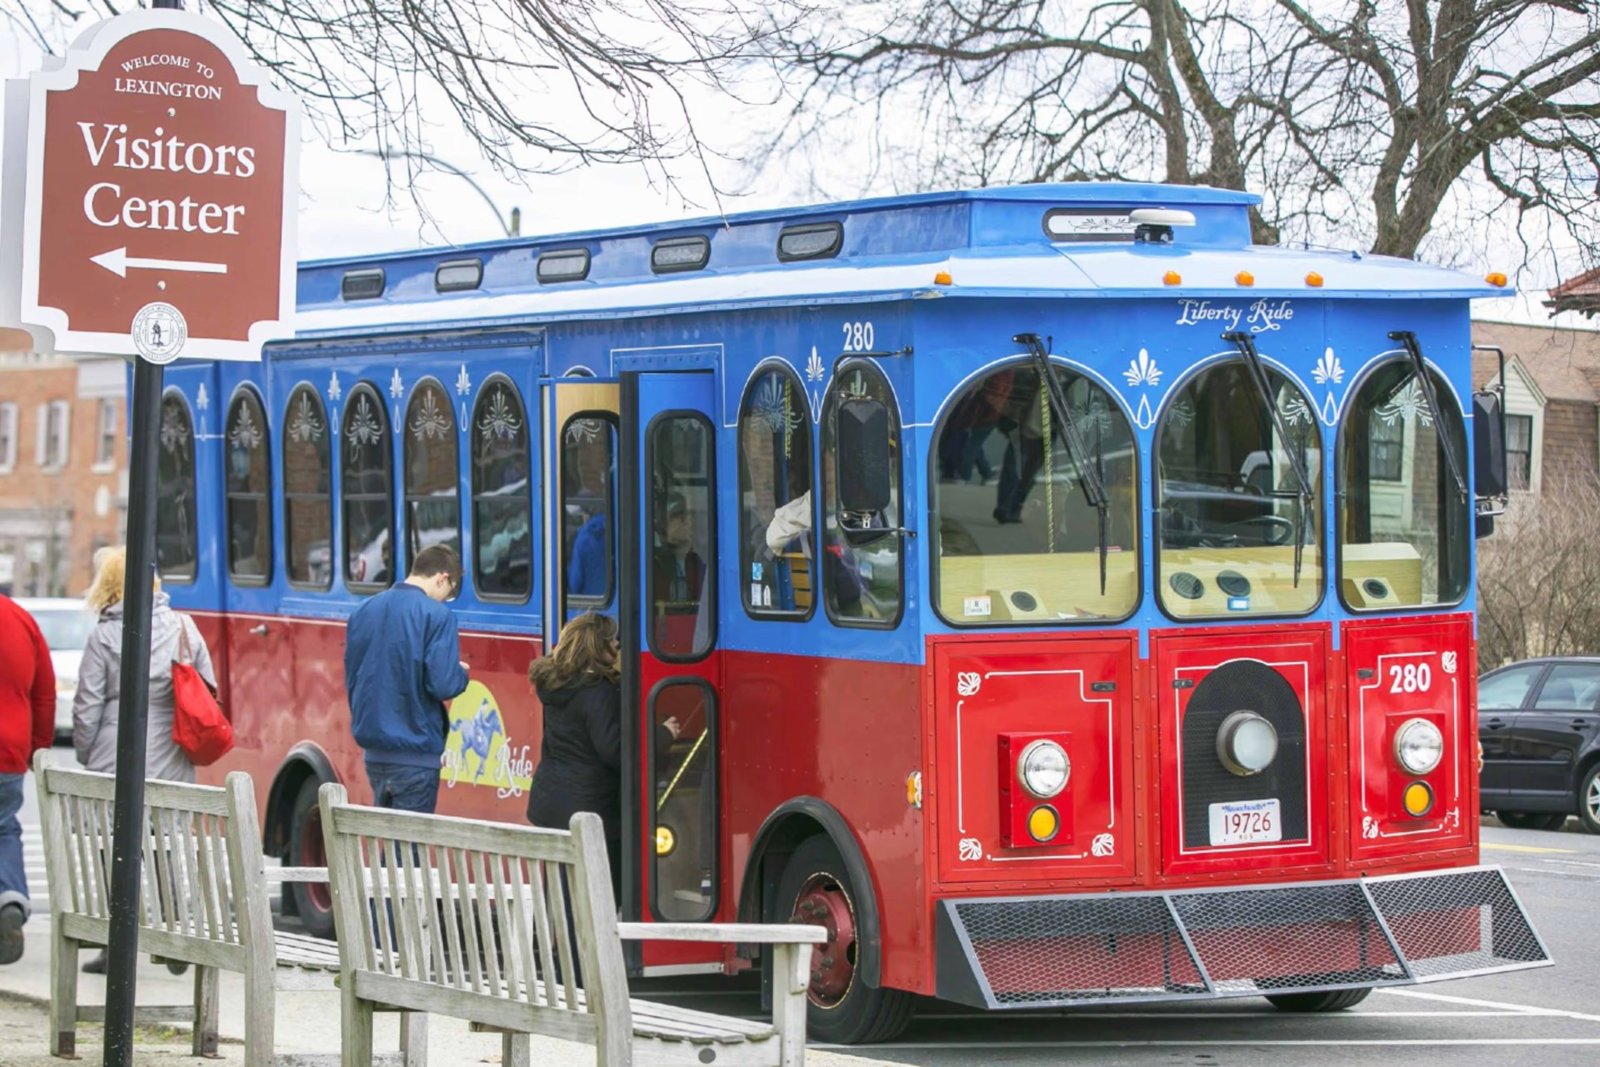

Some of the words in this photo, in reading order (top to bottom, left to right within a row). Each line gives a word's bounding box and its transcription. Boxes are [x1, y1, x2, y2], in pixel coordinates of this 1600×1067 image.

[121, 54, 190, 73] WELCOME
[196, 62, 214, 79] TO
[114, 78, 222, 100] LEXINGTON
[77, 121, 255, 177] Visitors
[83, 182, 245, 234] Center
[1176, 298, 1242, 331] Liberty
[1247, 297, 1294, 333] Ride
[842, 321, 874, 351] 280
[1389, 662, 1432, 693] 280
[496, 736, 533, 799] Ride
[1224, 811, 1272, 835] 19726
